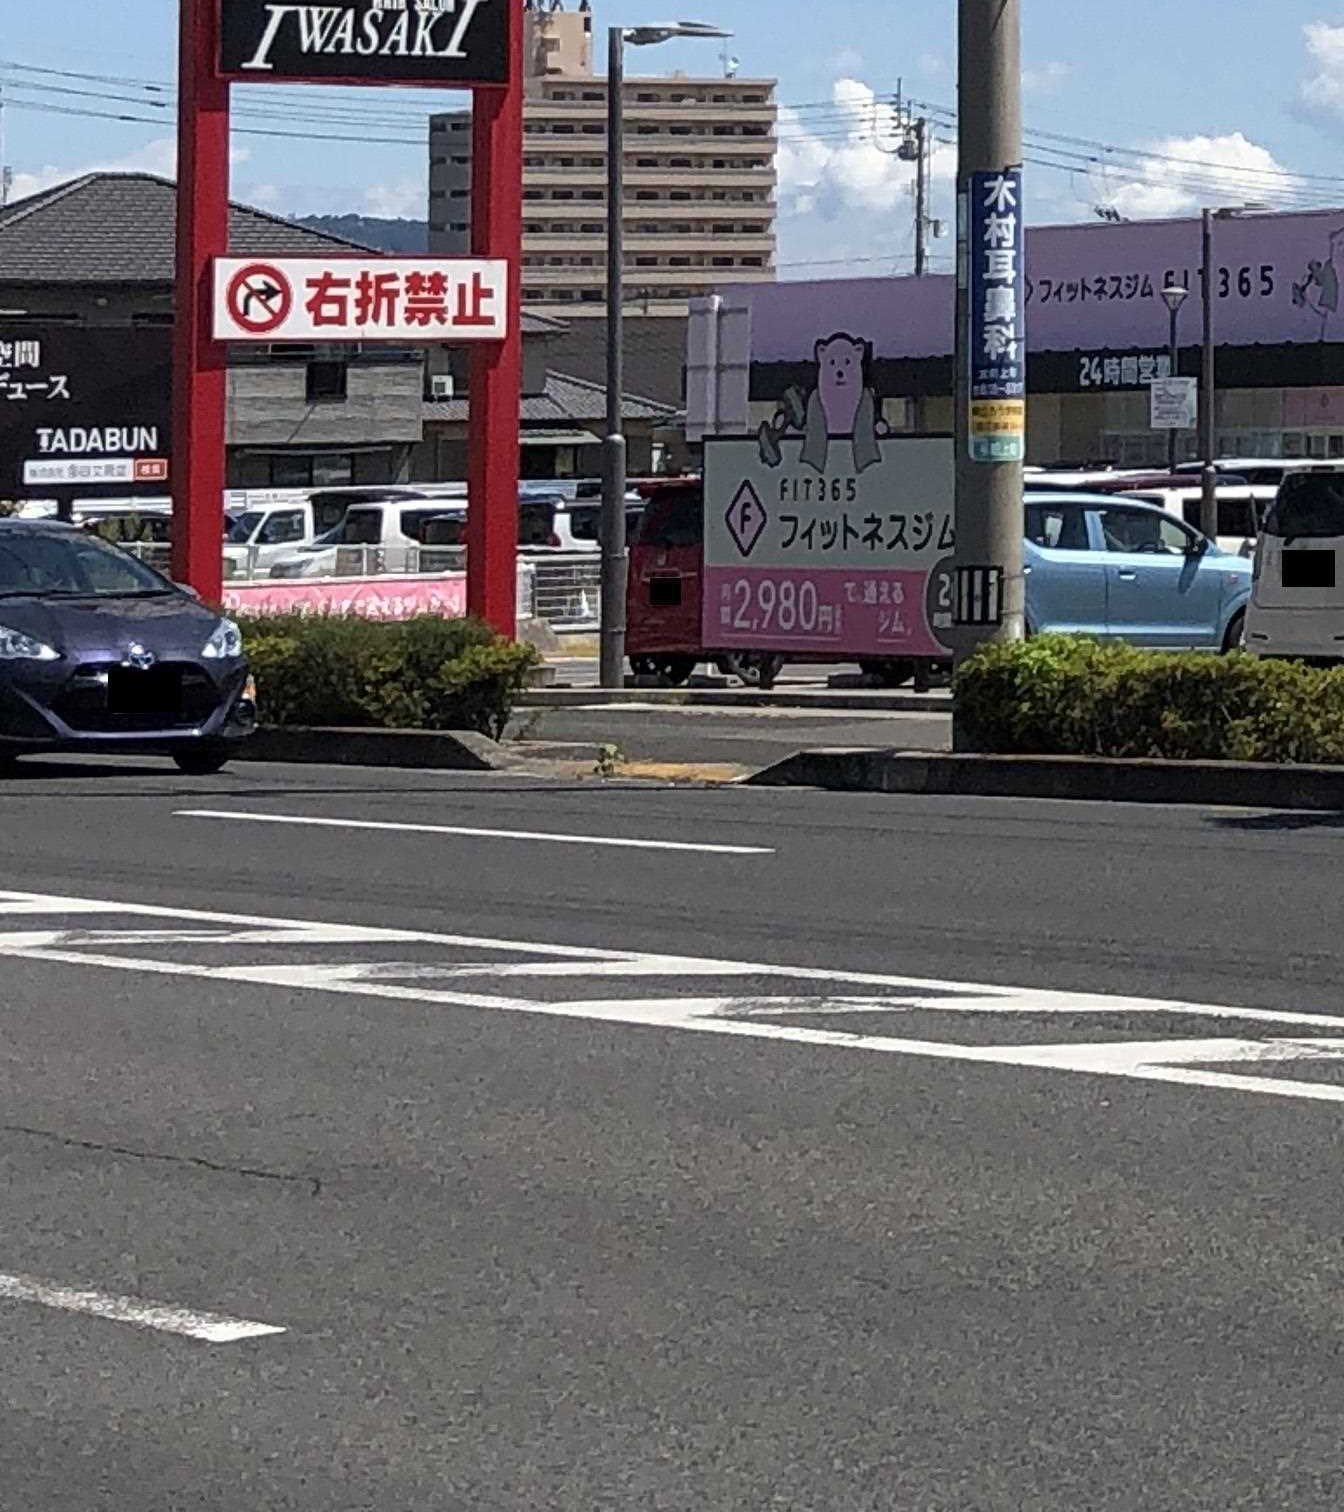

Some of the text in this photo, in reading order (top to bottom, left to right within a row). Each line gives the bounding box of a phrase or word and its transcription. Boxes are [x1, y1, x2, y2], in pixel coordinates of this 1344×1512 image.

[982, 174, 1017, 361] 木村耳鼻科
[305, 270, 496, 328] 右折禁止
[1039, 274, 1153, 303] フィットネスジム
[36, 426, 158, 453] TADABUN
[779, 478, 857, 502] FIT365
[779, 513, 956, 552] フィットネスジム
